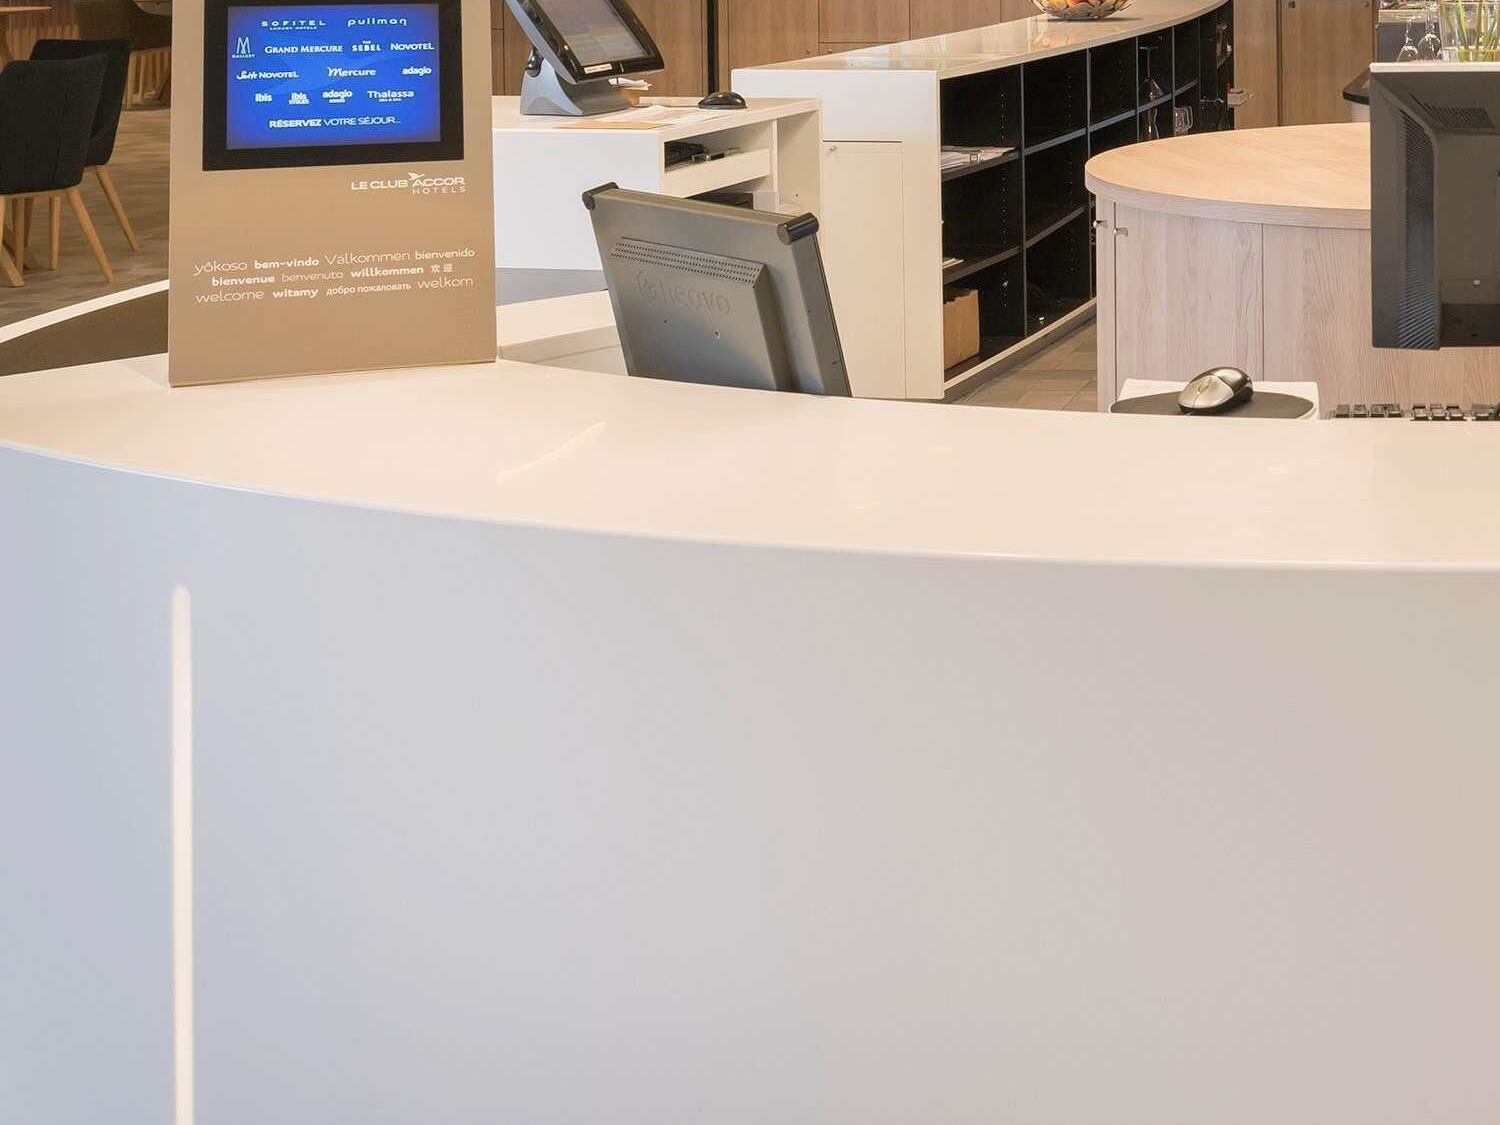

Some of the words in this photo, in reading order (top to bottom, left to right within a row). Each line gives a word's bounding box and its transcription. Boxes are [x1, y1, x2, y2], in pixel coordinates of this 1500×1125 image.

[347, 17, 407, 27] pullman
[264, 45, 299, 54] GRAND
[300, 44, 344, 53] MERCURE
[352, 43, 382, 52] SEBEL
[390, 42, 434, 51] NOVOTEL
[259, 70, 299, 79] NOVOTEL
[326, 66, 376, 77] Mercure
[402, 65, 432, 76] adagio
[255, 92, 273, 103] ibis
[322, 89, 353, 100] adagio
[367, 89, 415, 99] Thalassa
[323, 118, 357, 127] VOTRE
[351, 181, 369, 190] LE
[369, 179, 409, 189] CLUB
[411, 176, 465, 188] ACCOR
[411, 186, 467, 195] HOTELS
[254, 257, 320, 270] bem-vindo
[415, 248, 476, 260] bienvenido
[211, 275, 276, 287] bienvenue
[281, 272, 344, 283] benvenuto
[350, 267, 424, 278] willkommen
[417, 276, 474, 290] welkom
[326, 284, 356, 296] добро
[194, 290, 265, 304] welcome
[272, 288, 319, 299] witamy
